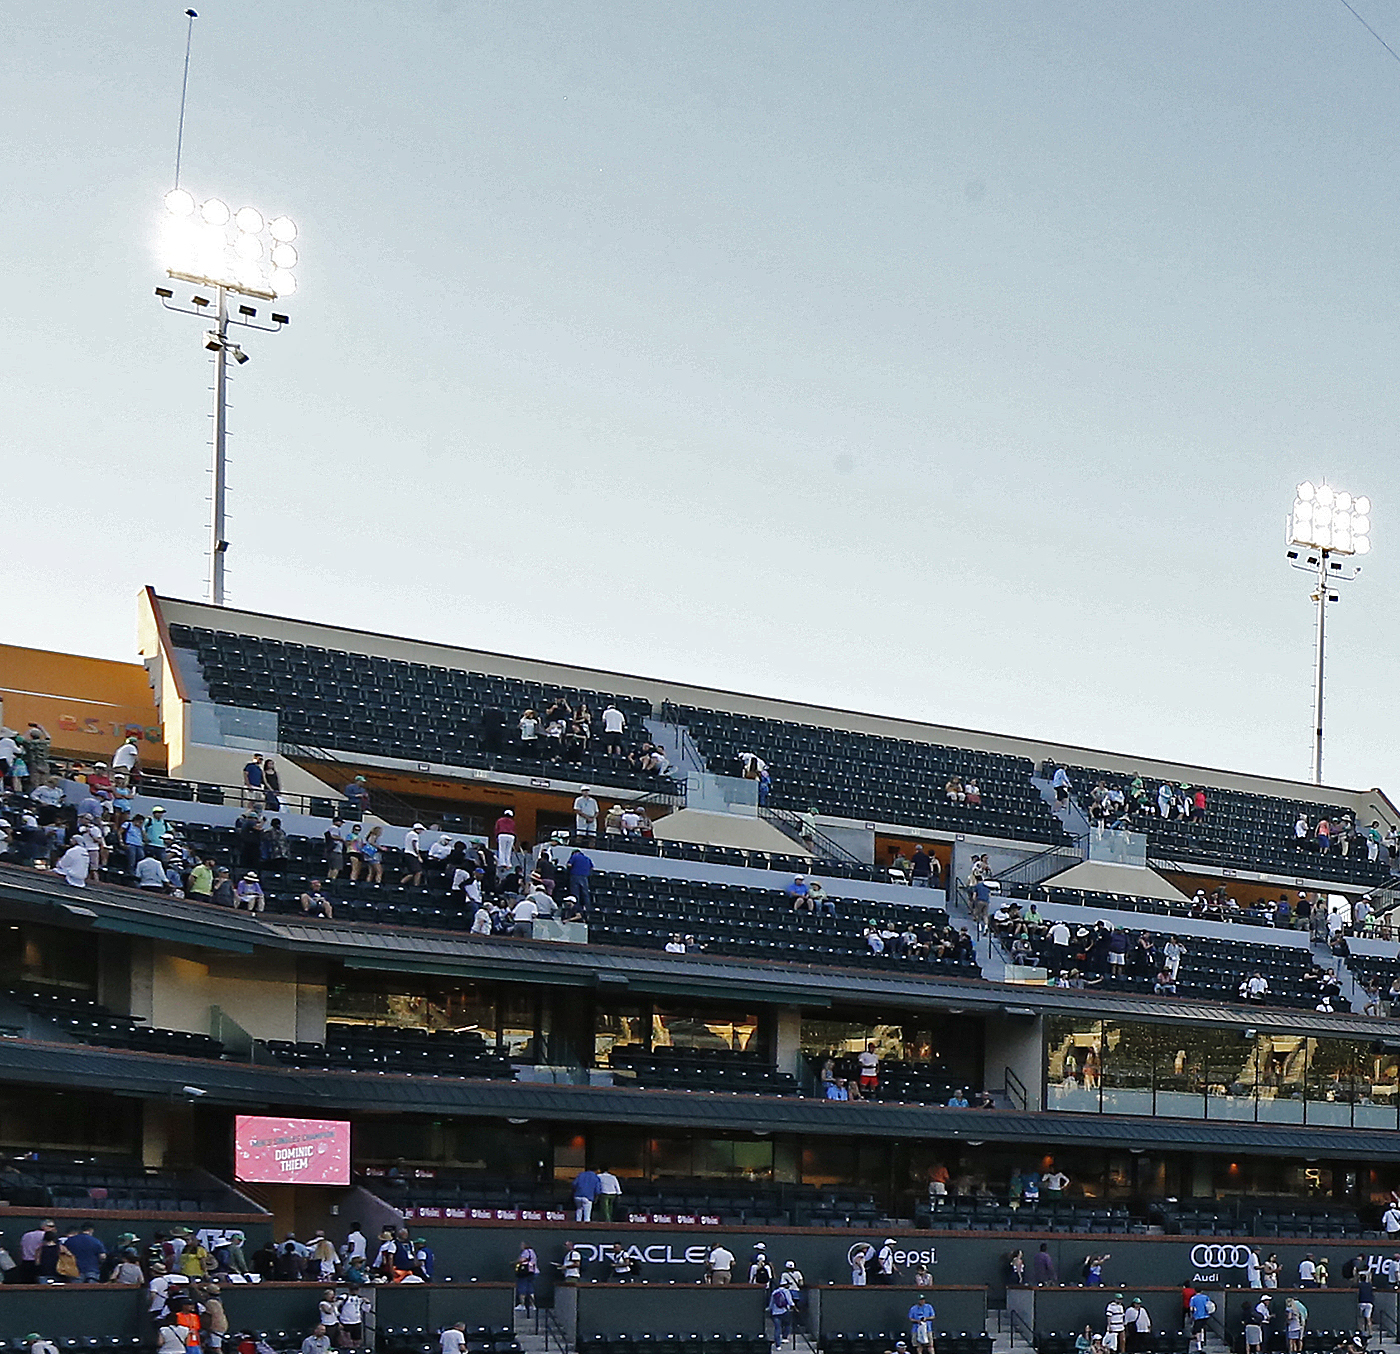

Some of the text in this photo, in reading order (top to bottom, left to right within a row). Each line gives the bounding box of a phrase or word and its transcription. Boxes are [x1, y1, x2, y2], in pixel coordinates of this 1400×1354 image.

[275, 1145, 314, 1161] DOMINIC
[280, 1158, 309, 1172] THIEM
[893, 1247, 938, 1265] epsi
[1192, 1273, 1219, 1282] Audi
